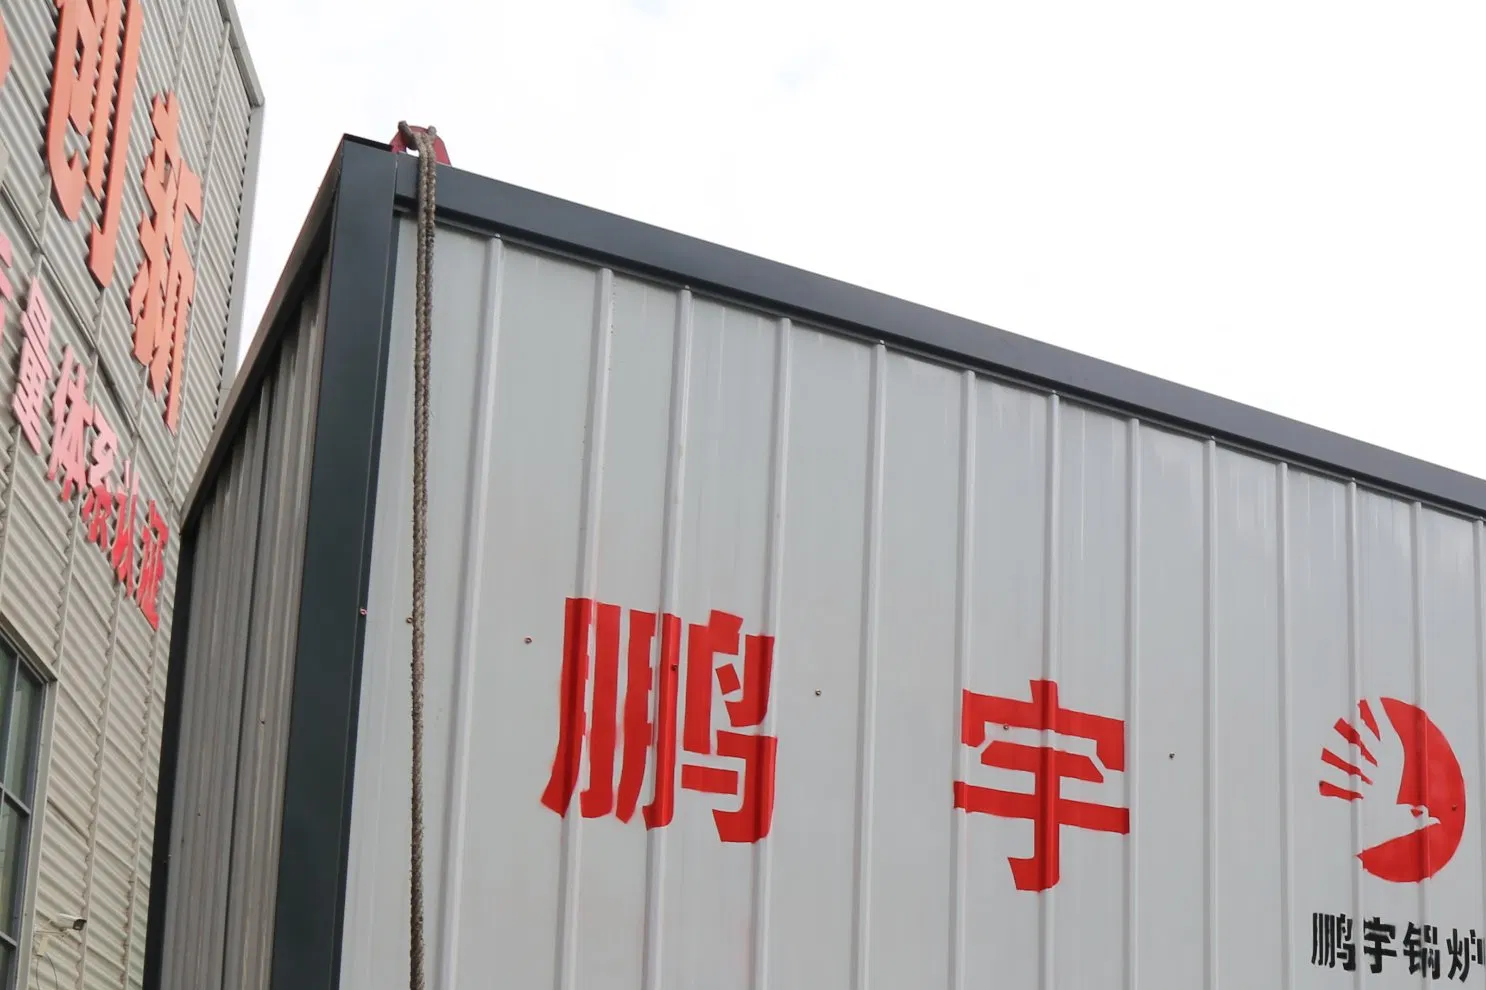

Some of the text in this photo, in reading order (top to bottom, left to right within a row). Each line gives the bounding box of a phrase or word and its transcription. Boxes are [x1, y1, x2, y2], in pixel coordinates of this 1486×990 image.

[0, 0, 201, 435] 创新
[0, 233, 168, 631] 量体系认证
[541, 597, 1130, 893] 鹏宇
[1311, 911, 1484, 983] 鹏宇锅炉
